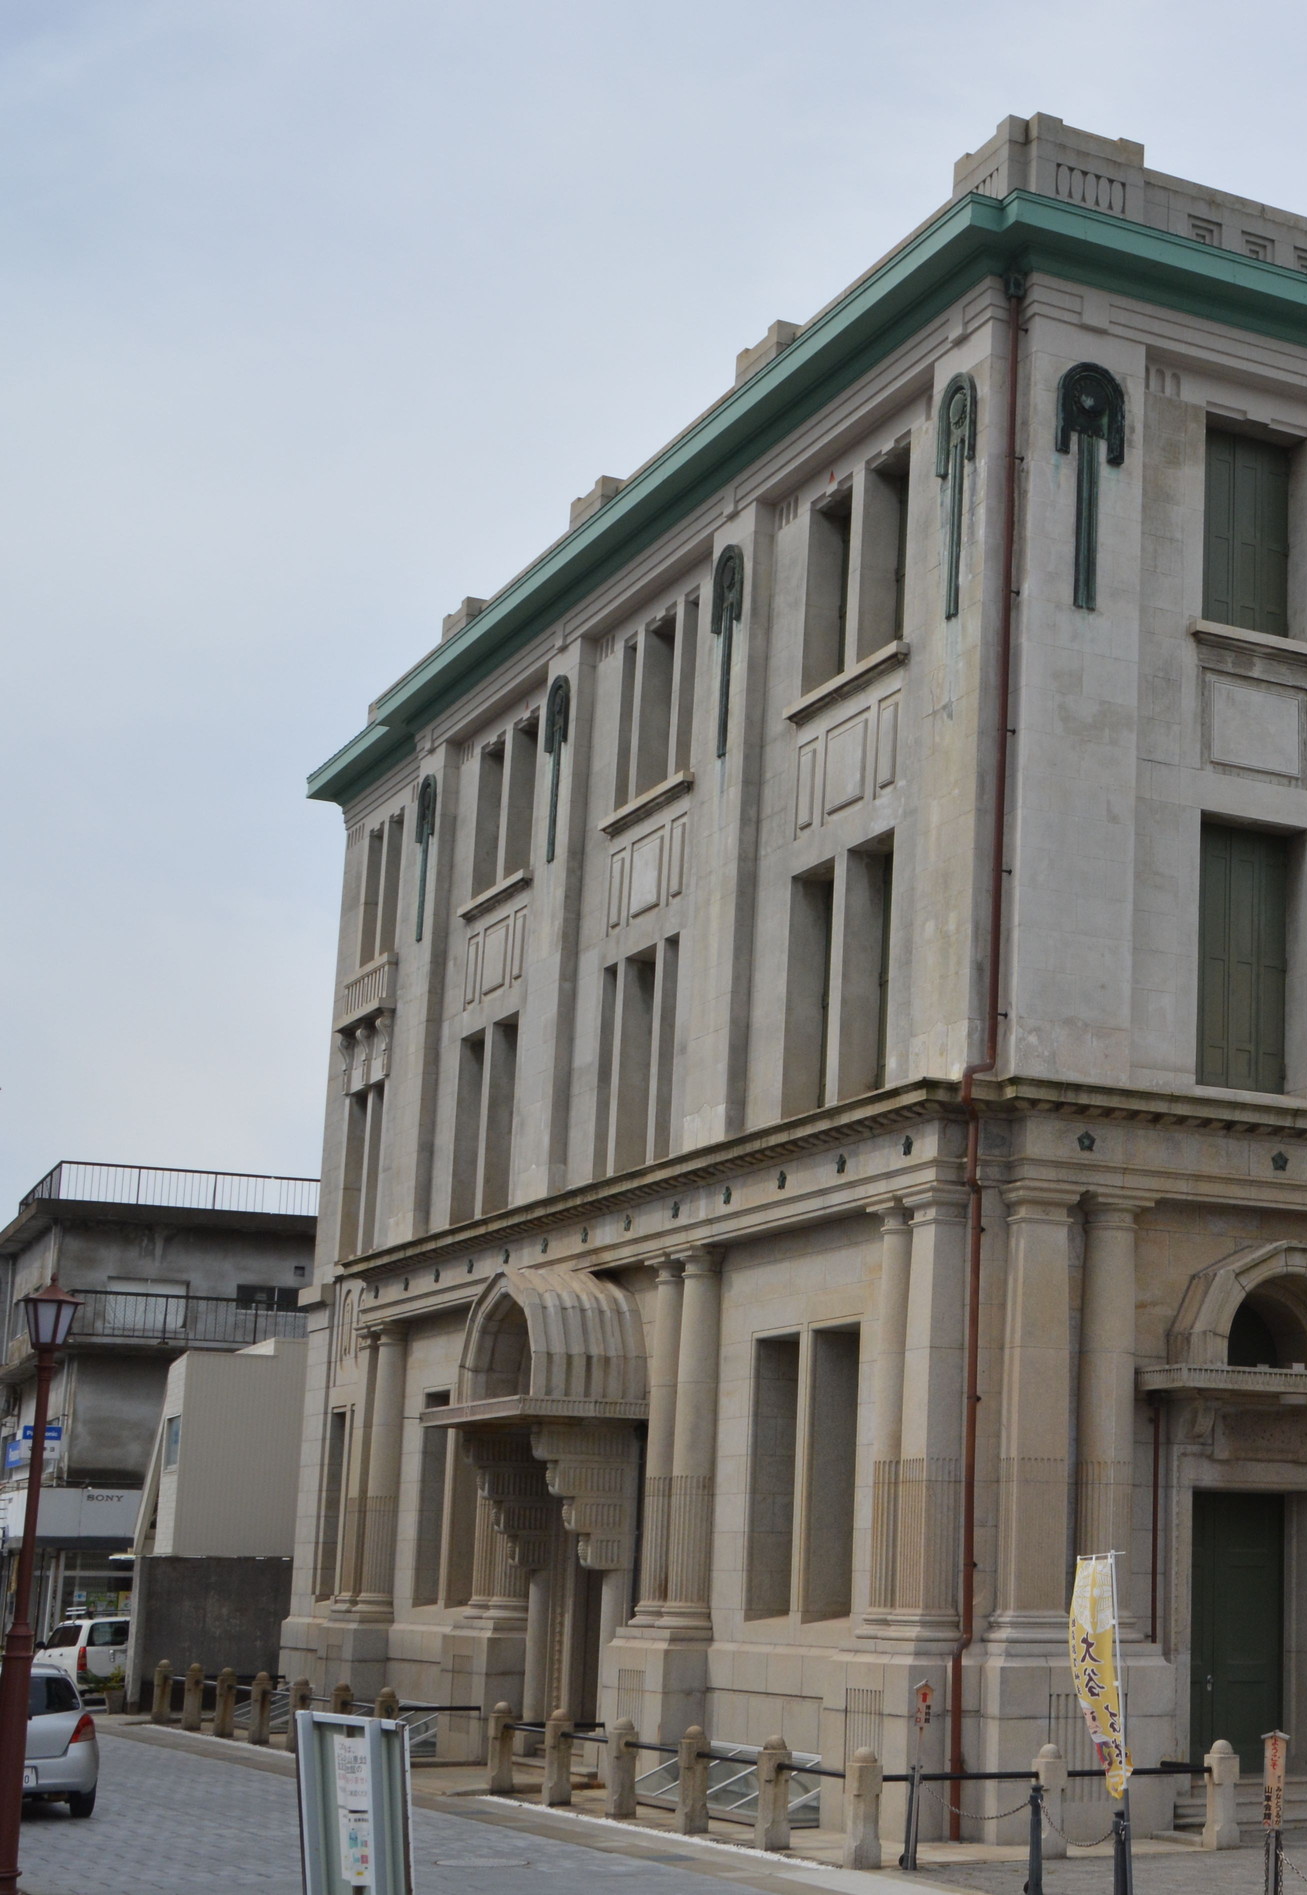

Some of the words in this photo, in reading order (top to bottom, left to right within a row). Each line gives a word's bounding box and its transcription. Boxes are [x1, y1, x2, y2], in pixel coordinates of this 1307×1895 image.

[26, 1430, 58, 1438] Paonic
[86, 1494, 124, 1502] SONY
[1271, 1736, 1279, 1770] ようこそ
